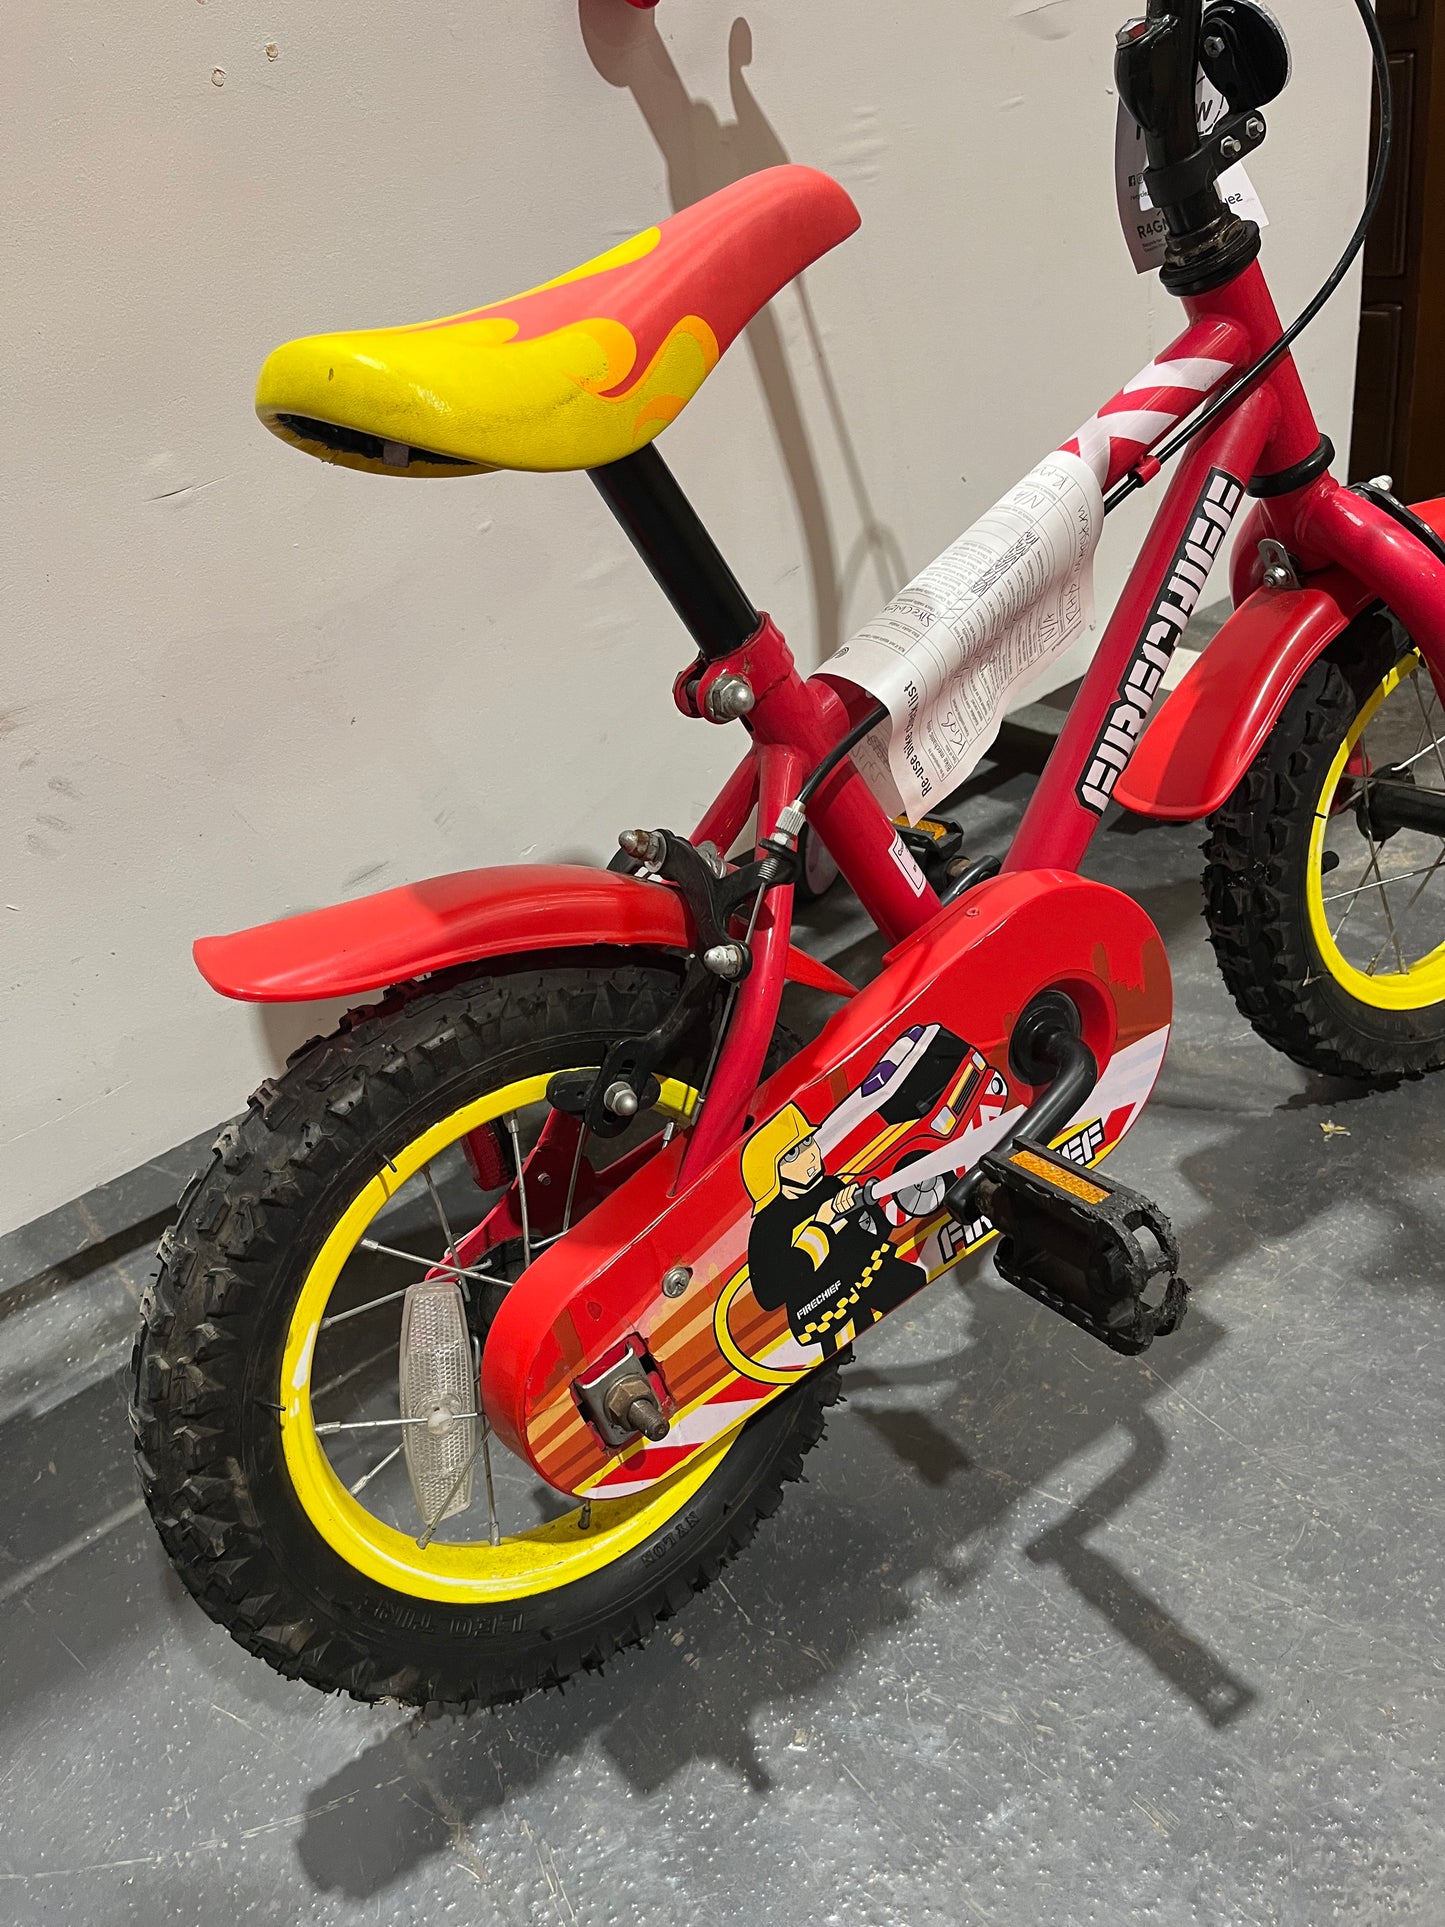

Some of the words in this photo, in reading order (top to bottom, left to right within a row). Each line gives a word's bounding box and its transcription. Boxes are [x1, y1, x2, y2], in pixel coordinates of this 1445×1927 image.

[1081, 474, 1241, 813] FIRECHIEF
[904, 681, 918, 707] list
[904, 732, 914, 759] bike
[909, 754, 932, 797] Re-use
[796, 1279, 841, 1320] FIRECHIEF
[641, 1511, 700, 1567] NYLON
[449, 1613, 524, 1637] LEO
